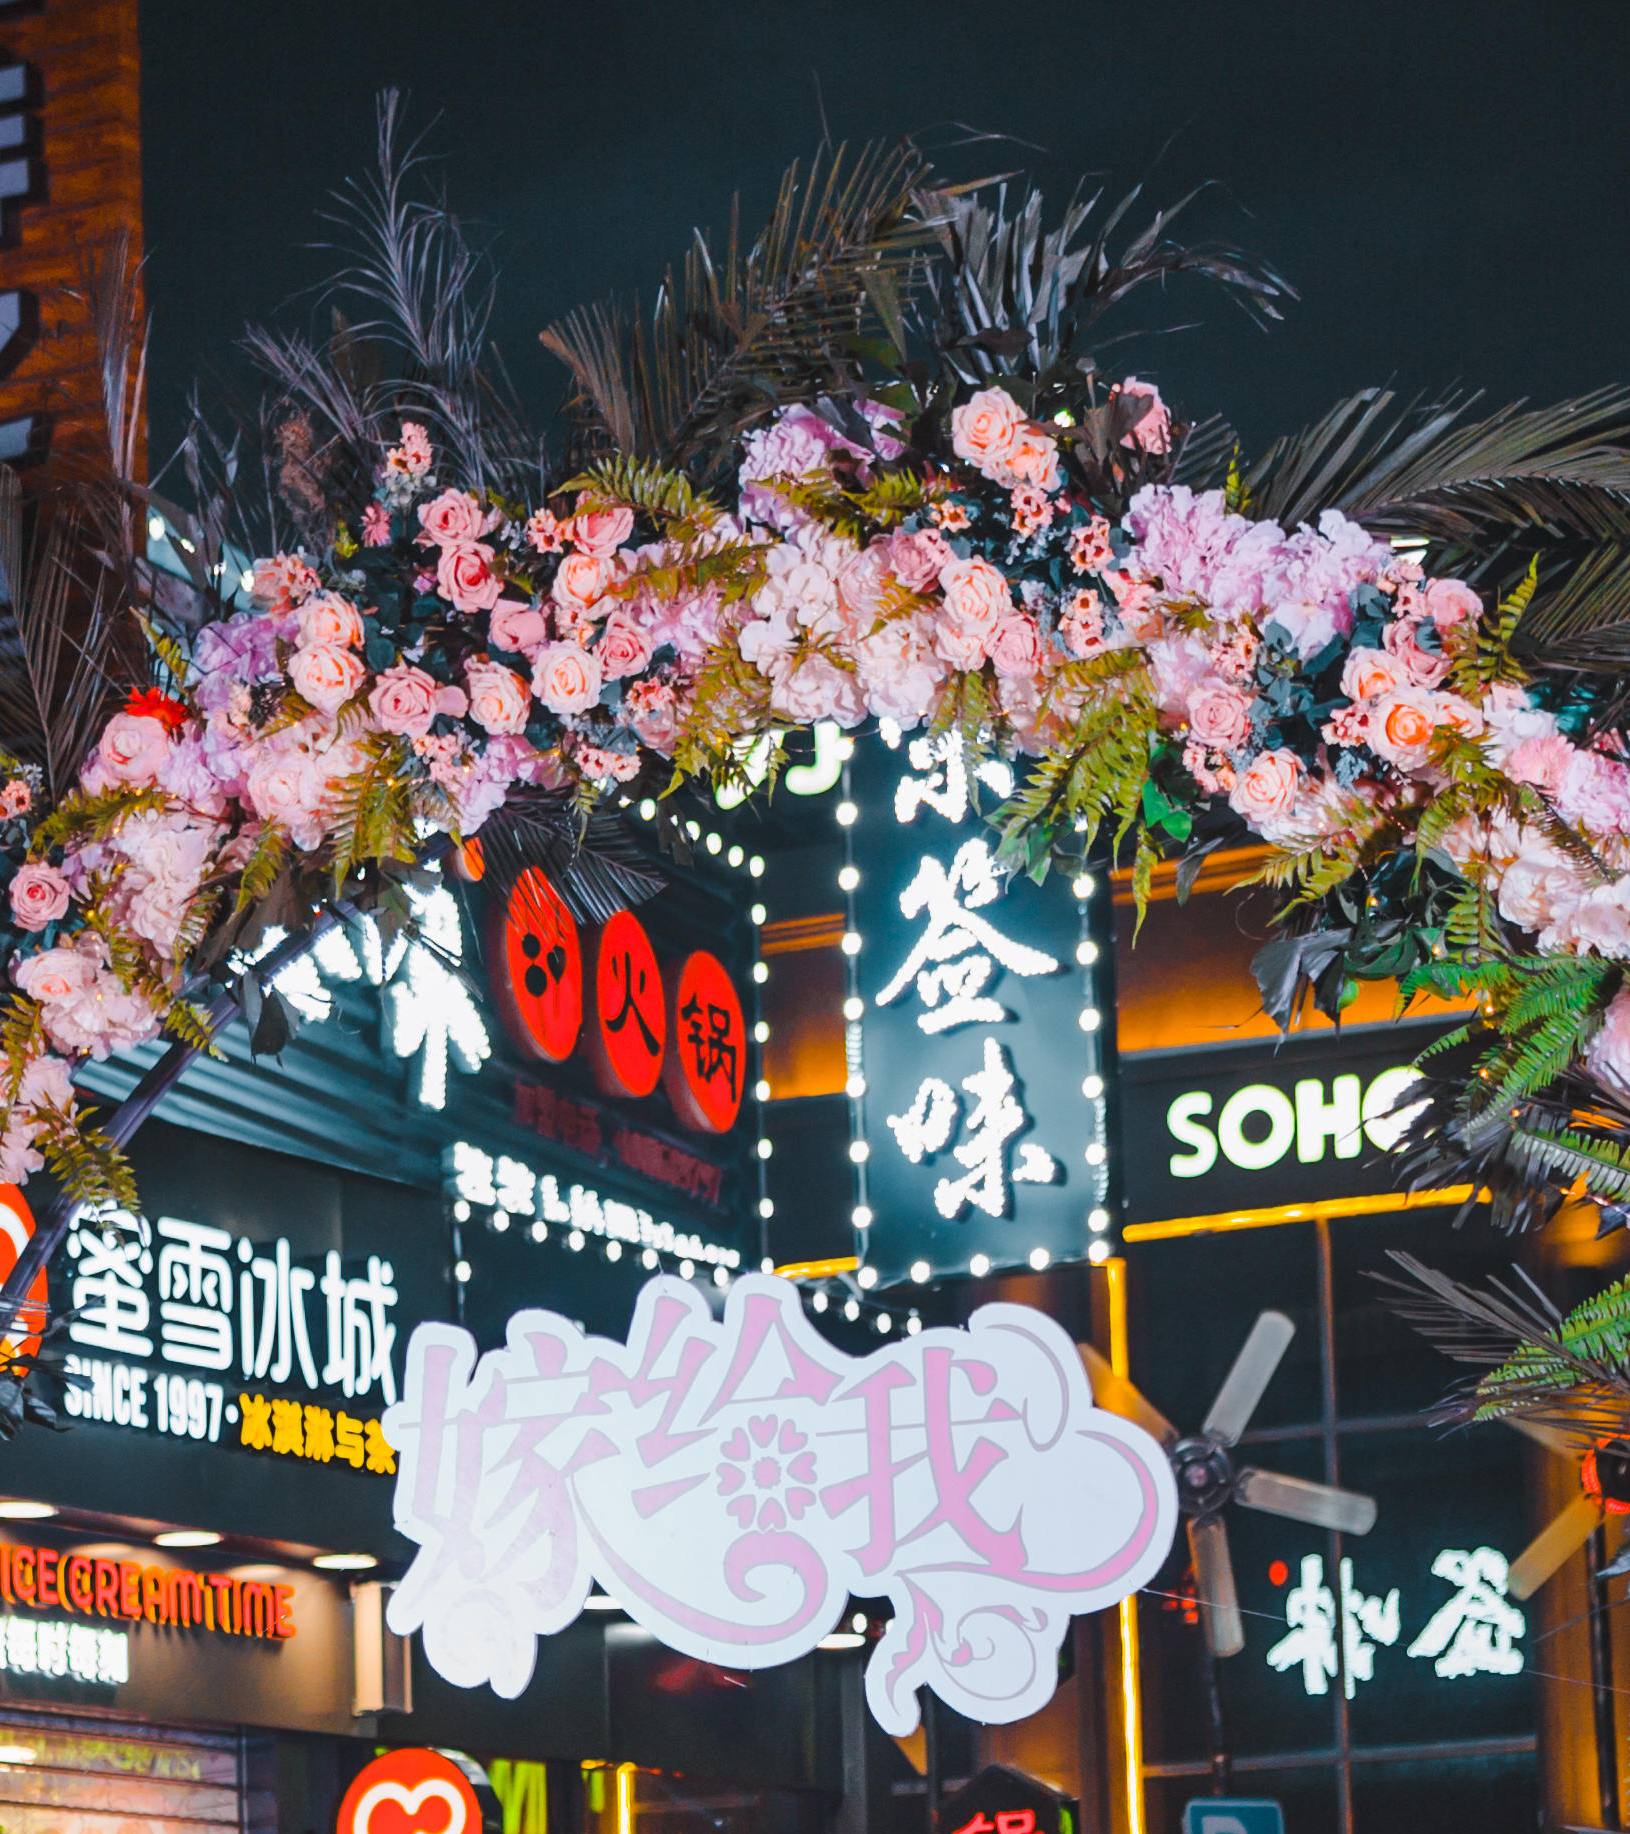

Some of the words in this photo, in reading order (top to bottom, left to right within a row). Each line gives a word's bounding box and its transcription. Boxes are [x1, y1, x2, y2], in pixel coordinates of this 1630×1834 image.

[604, 951, 738, 1103] 火锅
[66, 1198, 399, 1406] 蜜雪冰城
[63, 1353, 149, 1428] SINCE
[153, 1373, 224, 1443] 1997
[399, 1292, 1157, 1645] 嫁给我
[0, 1546, 61, 1609] ICE
[69, 1556, 205, 1630] CREAM
[209, 1573, 297, 1640] TIME
